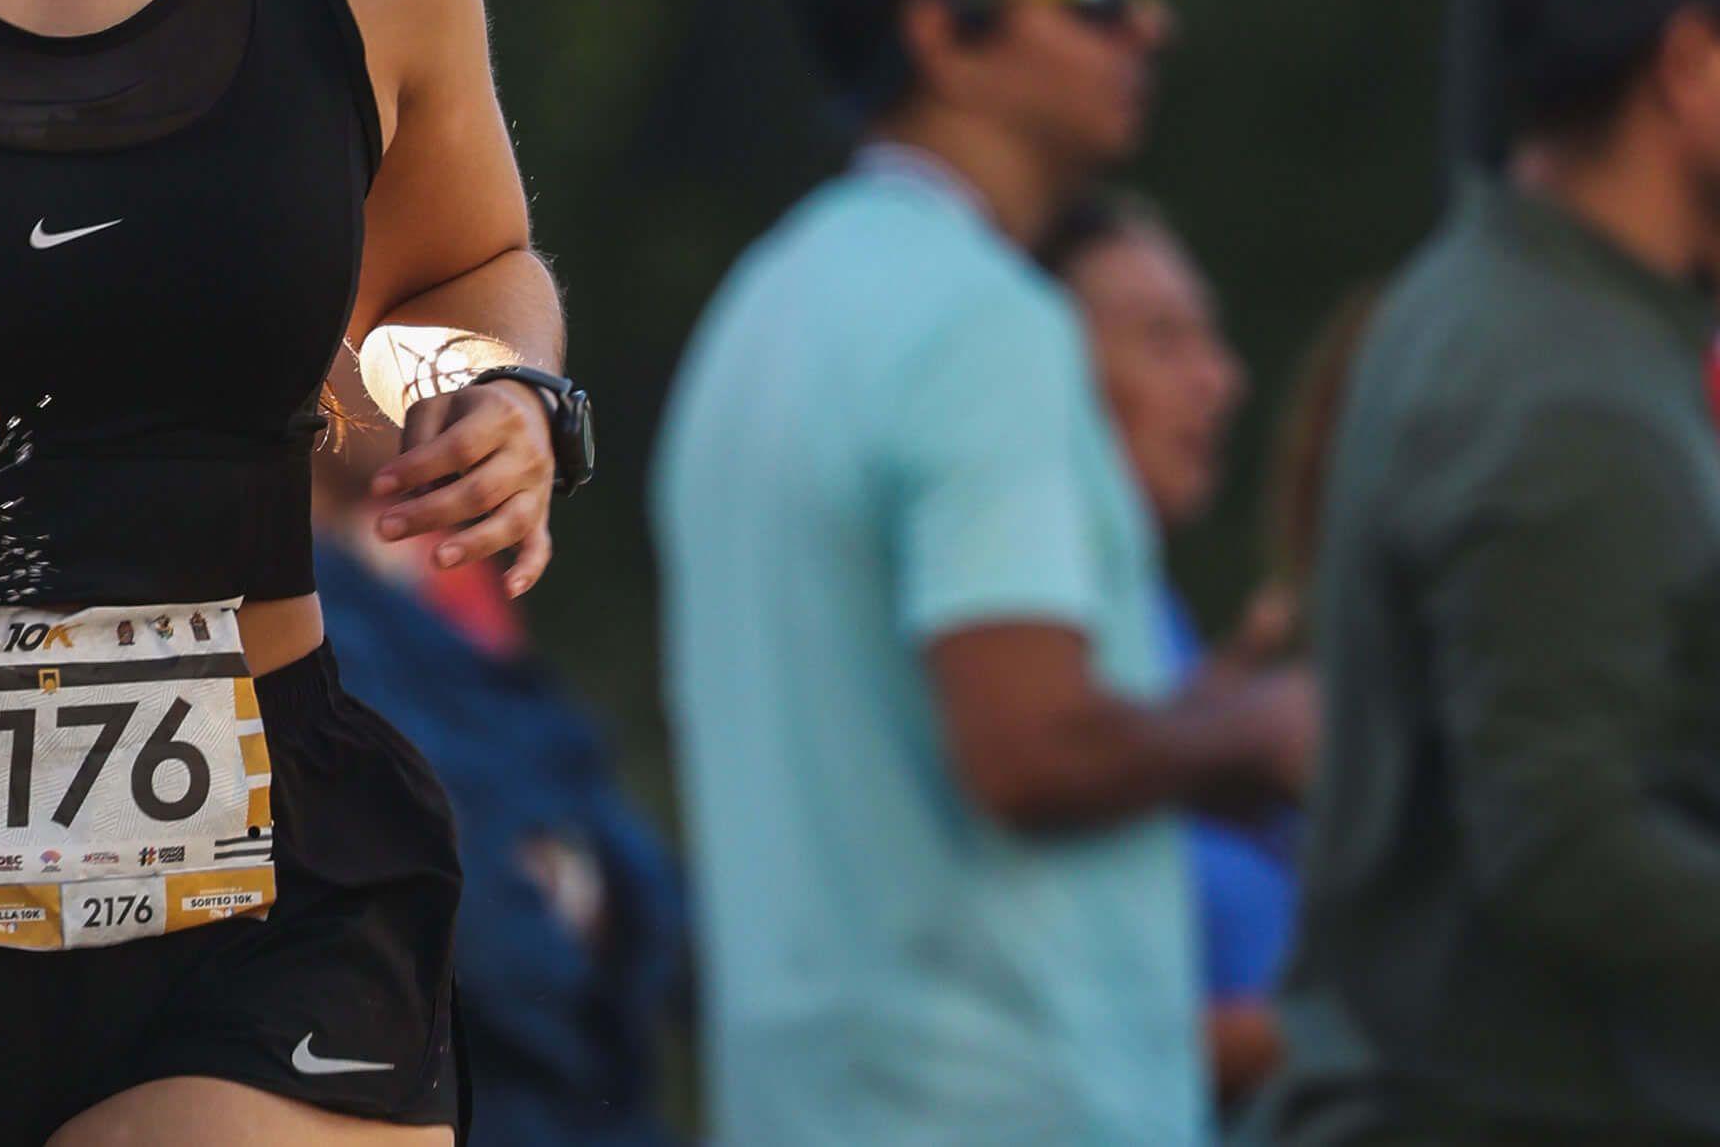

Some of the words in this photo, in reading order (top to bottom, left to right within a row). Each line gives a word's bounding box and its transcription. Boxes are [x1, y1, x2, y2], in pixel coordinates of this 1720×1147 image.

[4, 622, 84, 653] 10K
[82, 896, 153, 928] 2176
[191, 897, 231, 908] SORTEO
[234, 893, 253, 904] 10K
[21, 909, 41, 920] 10K
